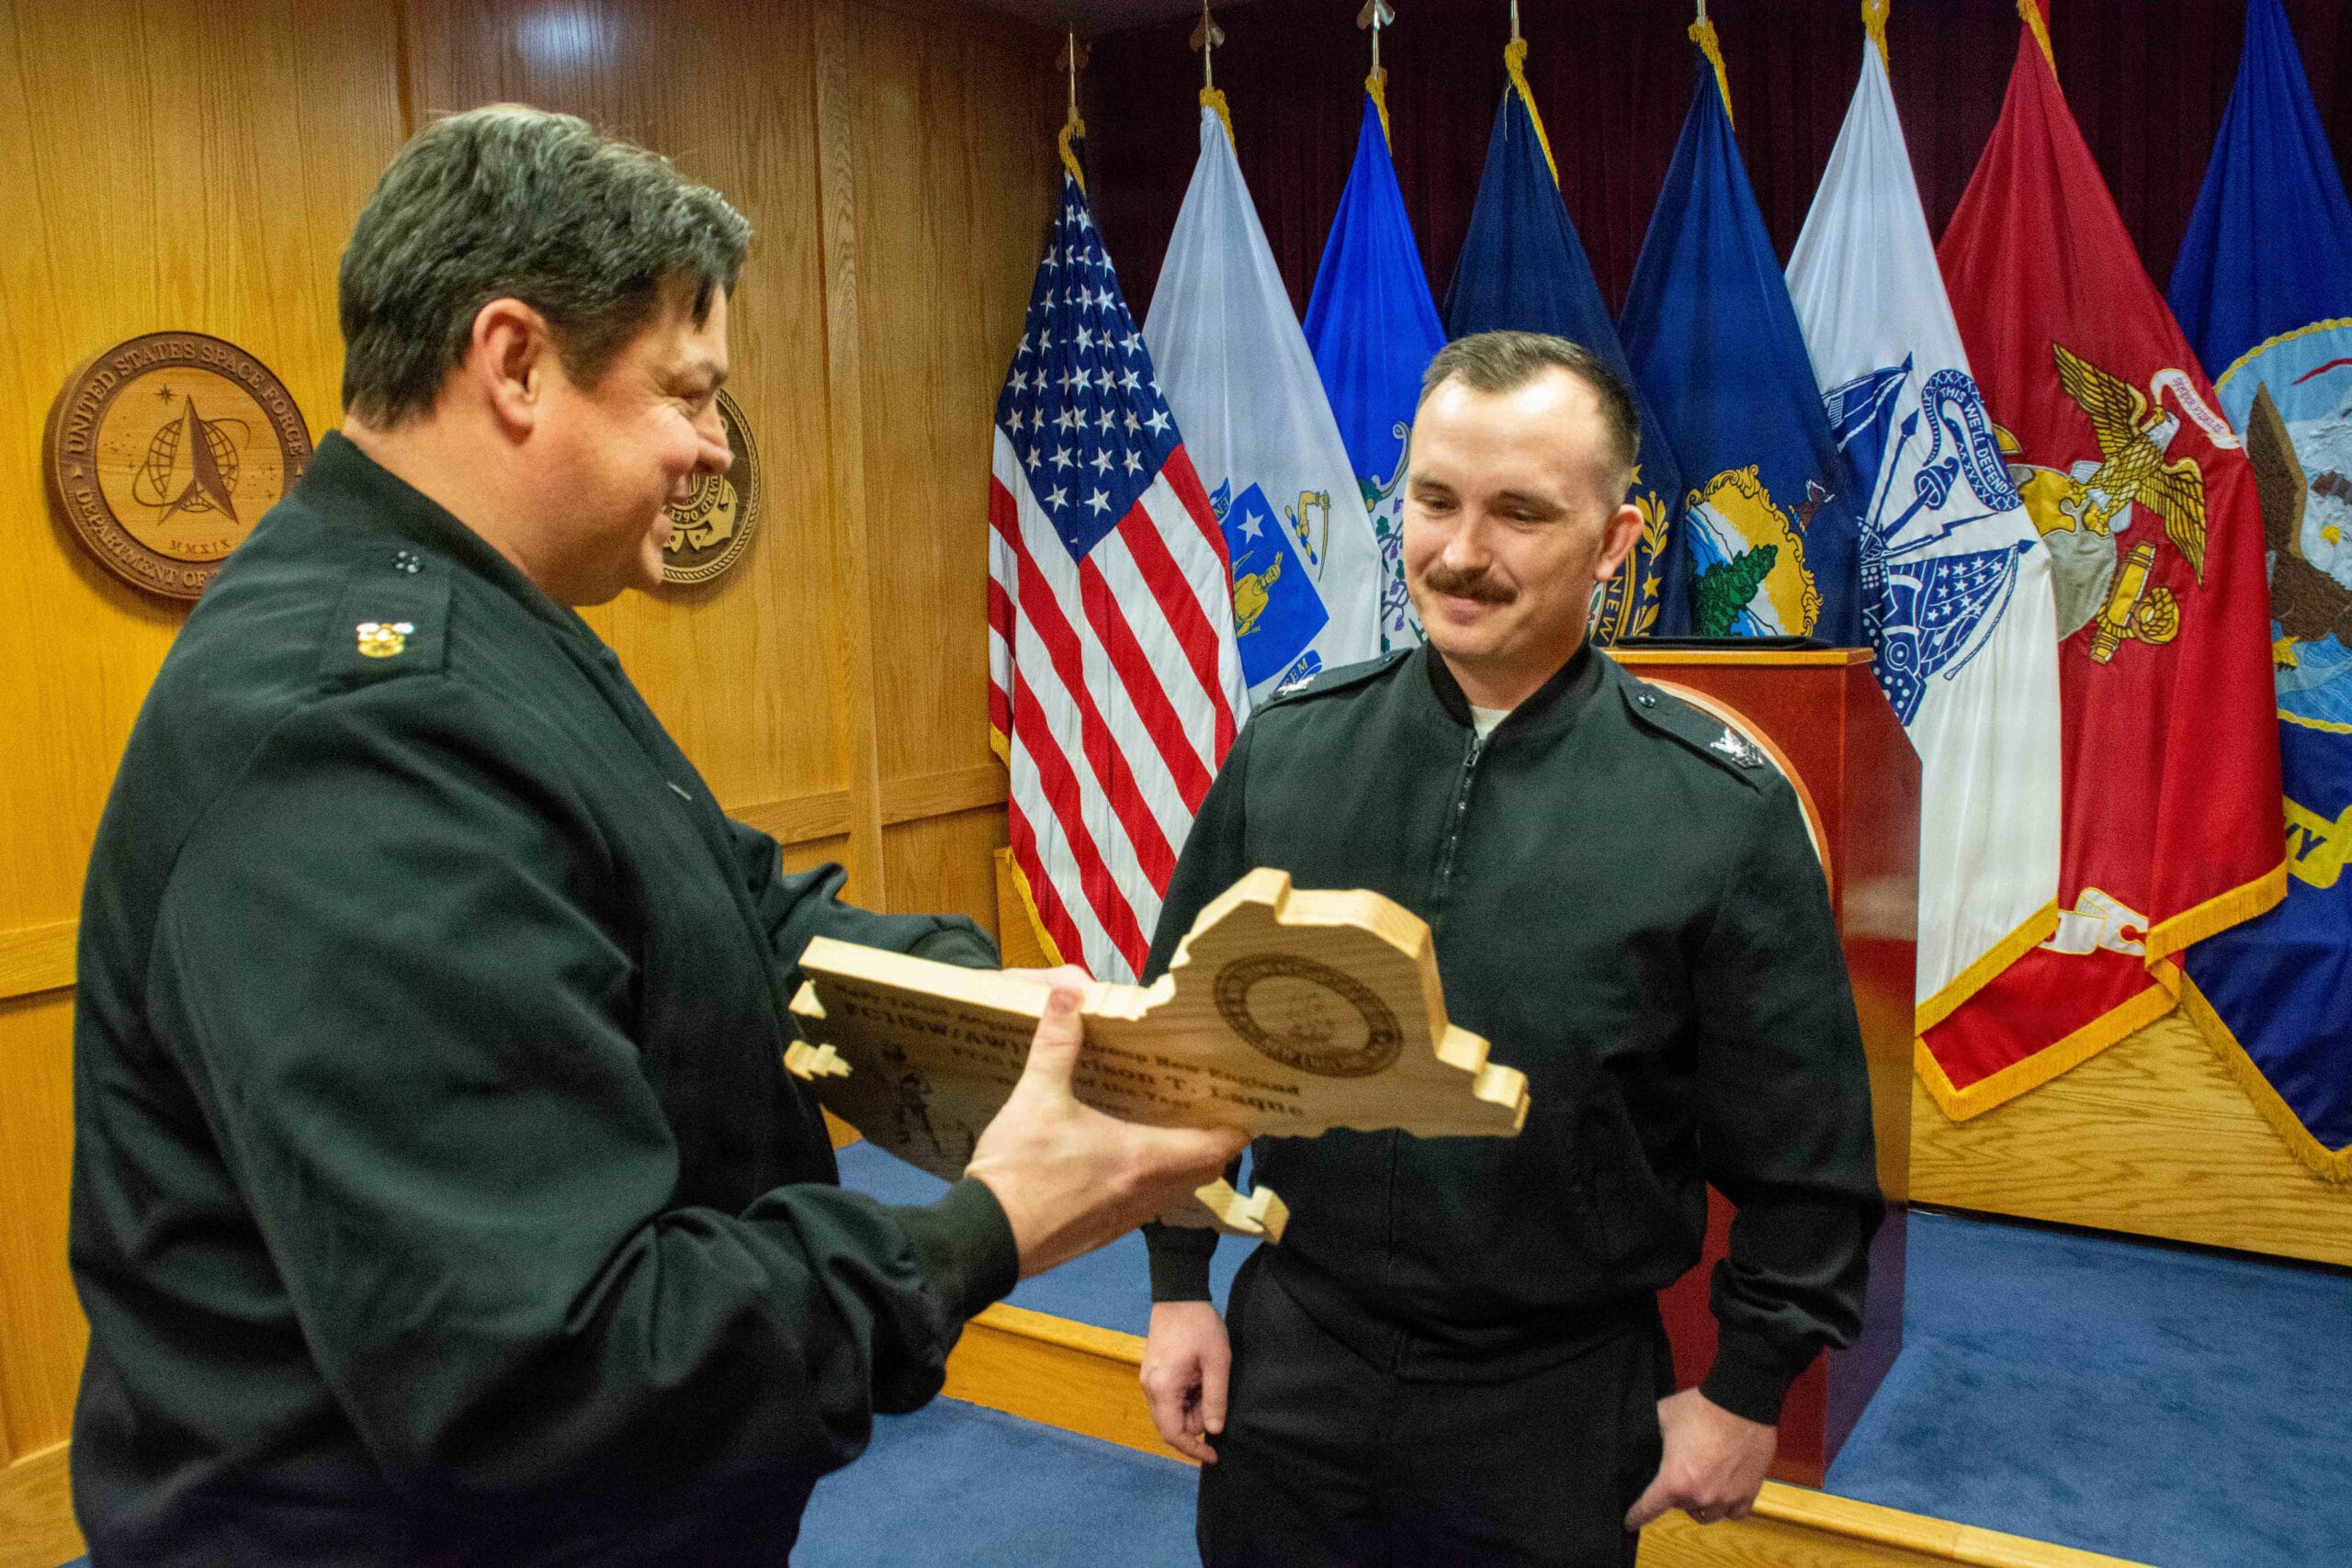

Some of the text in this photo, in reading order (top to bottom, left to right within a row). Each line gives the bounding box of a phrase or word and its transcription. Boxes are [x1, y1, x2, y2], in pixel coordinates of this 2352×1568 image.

[68, 343, 304, 457] UNITED STATES SPACE FORCE
[1939, 386, 2008, 493] THIS WE'LL DEFEND
[702, 476, 718, 513] UARD
[75, 489, 208, 587] DEPARTMENT OF
[170, 539, 231, 555] MMXIX
[1600, 576, 1623, 642] NEW
